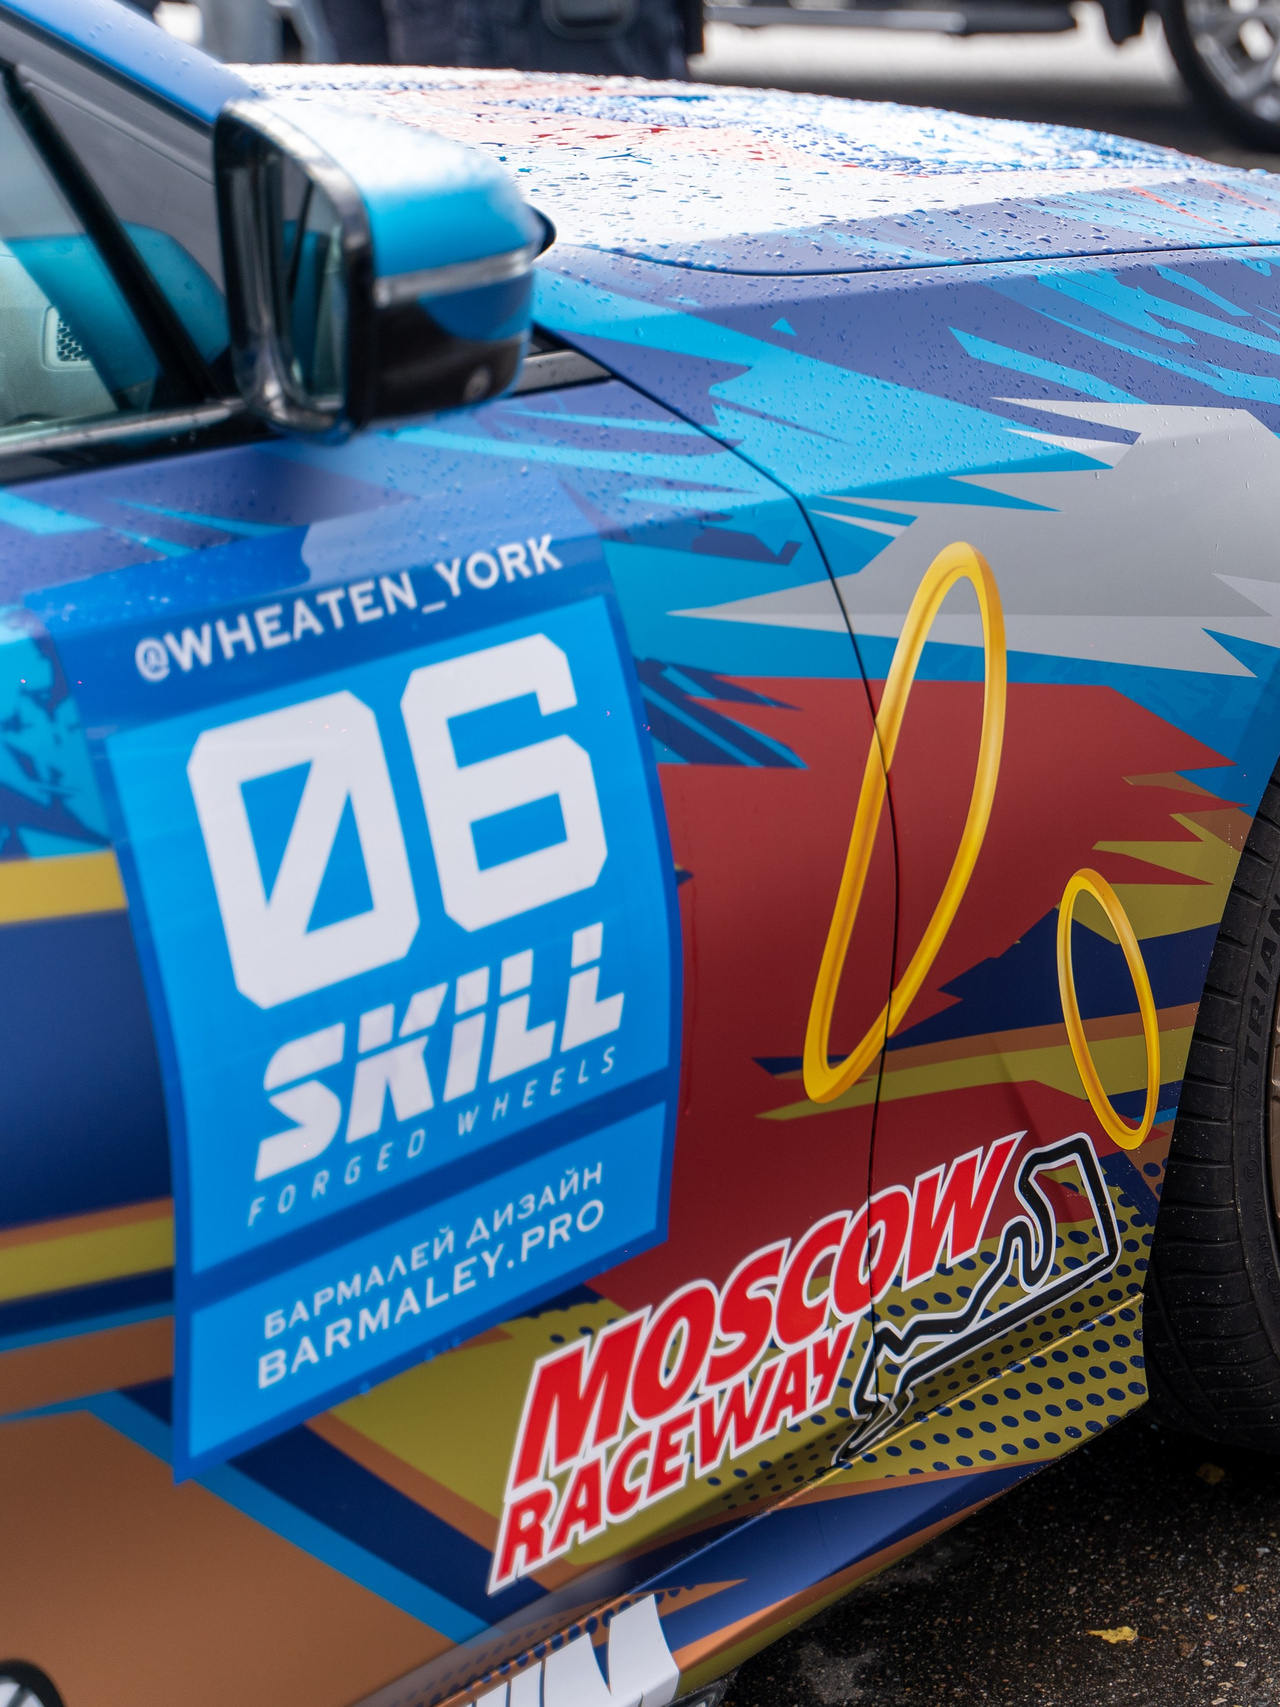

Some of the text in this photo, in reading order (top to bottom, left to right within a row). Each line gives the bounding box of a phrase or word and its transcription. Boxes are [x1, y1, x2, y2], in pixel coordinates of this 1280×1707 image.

[135, 535, 562, 681] @WHEATEN_YORK
[186, 632, 608, 1010] 06
[247, 1046, 615, 1226] FORGED WHEELS
[254, 922, 624, 1182] SKILL
[258, 1199, 604, 1388] BARMALEY.PRO
[264, 1162, 602, 1339] БАРМАЛЕЙ ДИЗАЙН
[507, 1132, 1025, 1497] MOSCOW
[489, 1318, 859, 1594] RACEWAY
